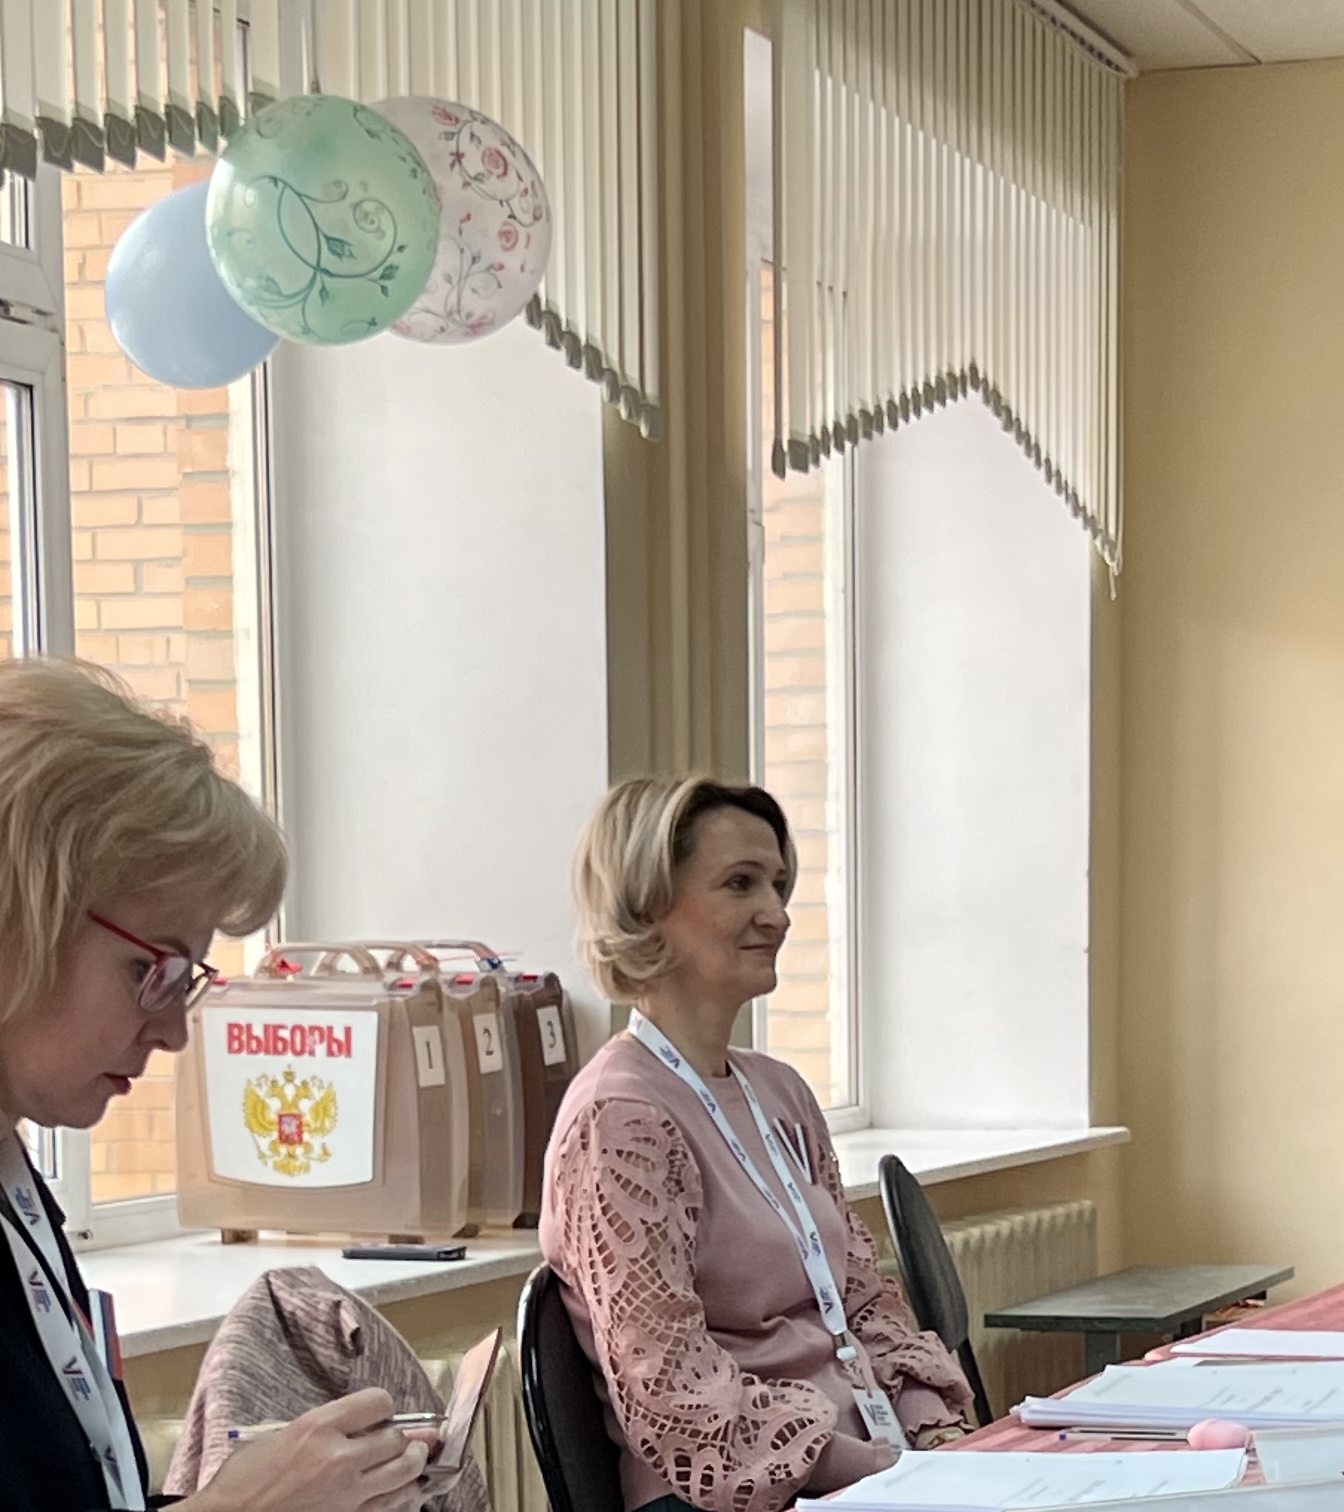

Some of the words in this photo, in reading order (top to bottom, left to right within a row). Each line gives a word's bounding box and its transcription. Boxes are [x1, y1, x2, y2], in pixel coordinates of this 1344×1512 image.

[226, 1022, 352, 1058] ВЫБОРЫ
[483, 1027, 494, 1056] 2
[547, 1020, 557, 1049] 3
[425, 1040, 434, 1069] 1
